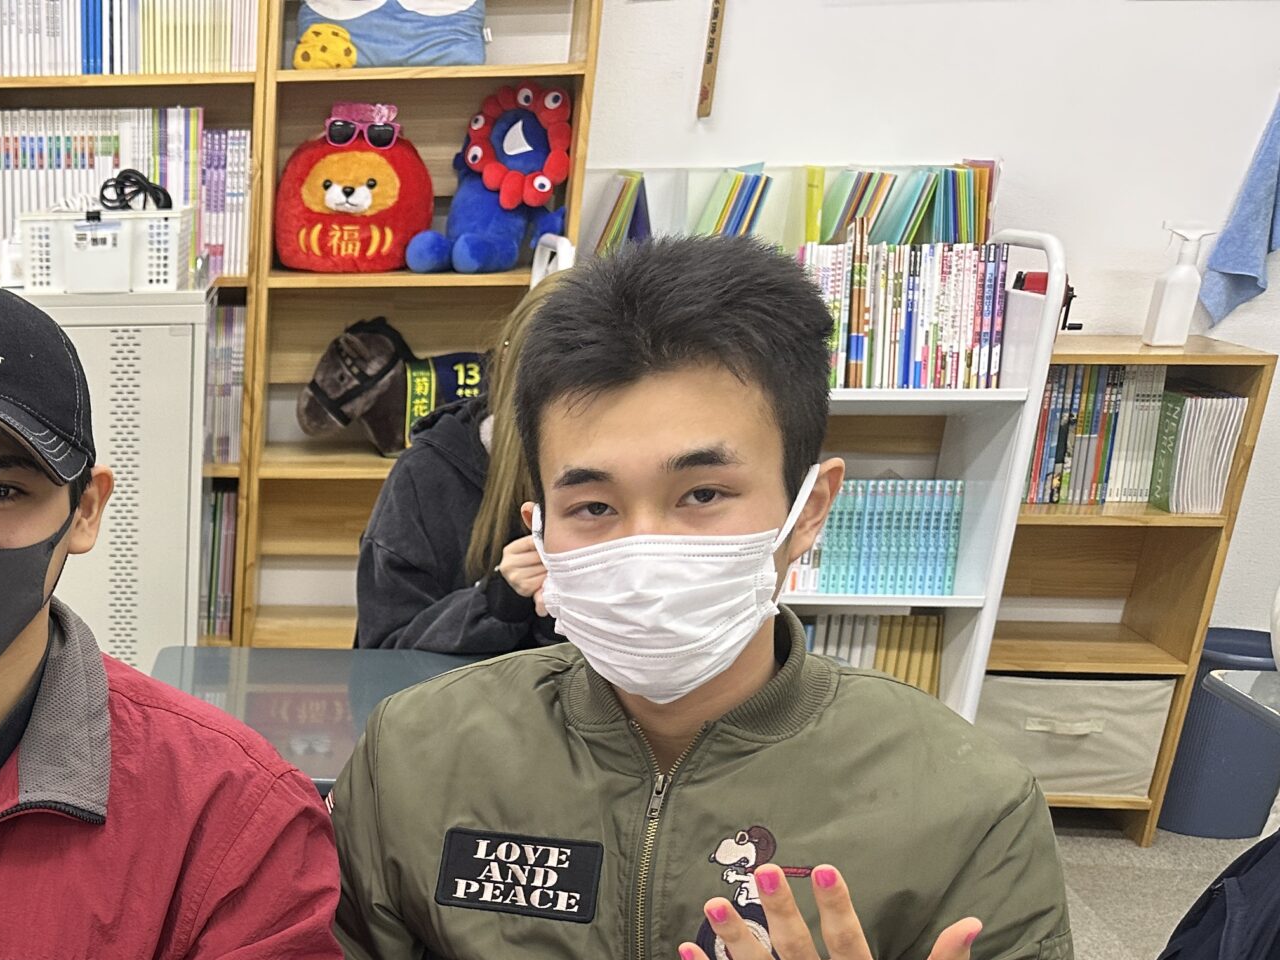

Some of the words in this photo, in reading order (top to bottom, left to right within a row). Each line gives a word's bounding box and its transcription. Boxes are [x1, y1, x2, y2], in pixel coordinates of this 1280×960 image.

[327, 224, 362, 257] 福
[453, 363, 480, 386] 13
[1154, 403, 1173, 498] HORIZON
[473, 839, 571, 868] LOVE
[476, 861, 558, 888] AND
[452, 878, 581, 912] PEACE
